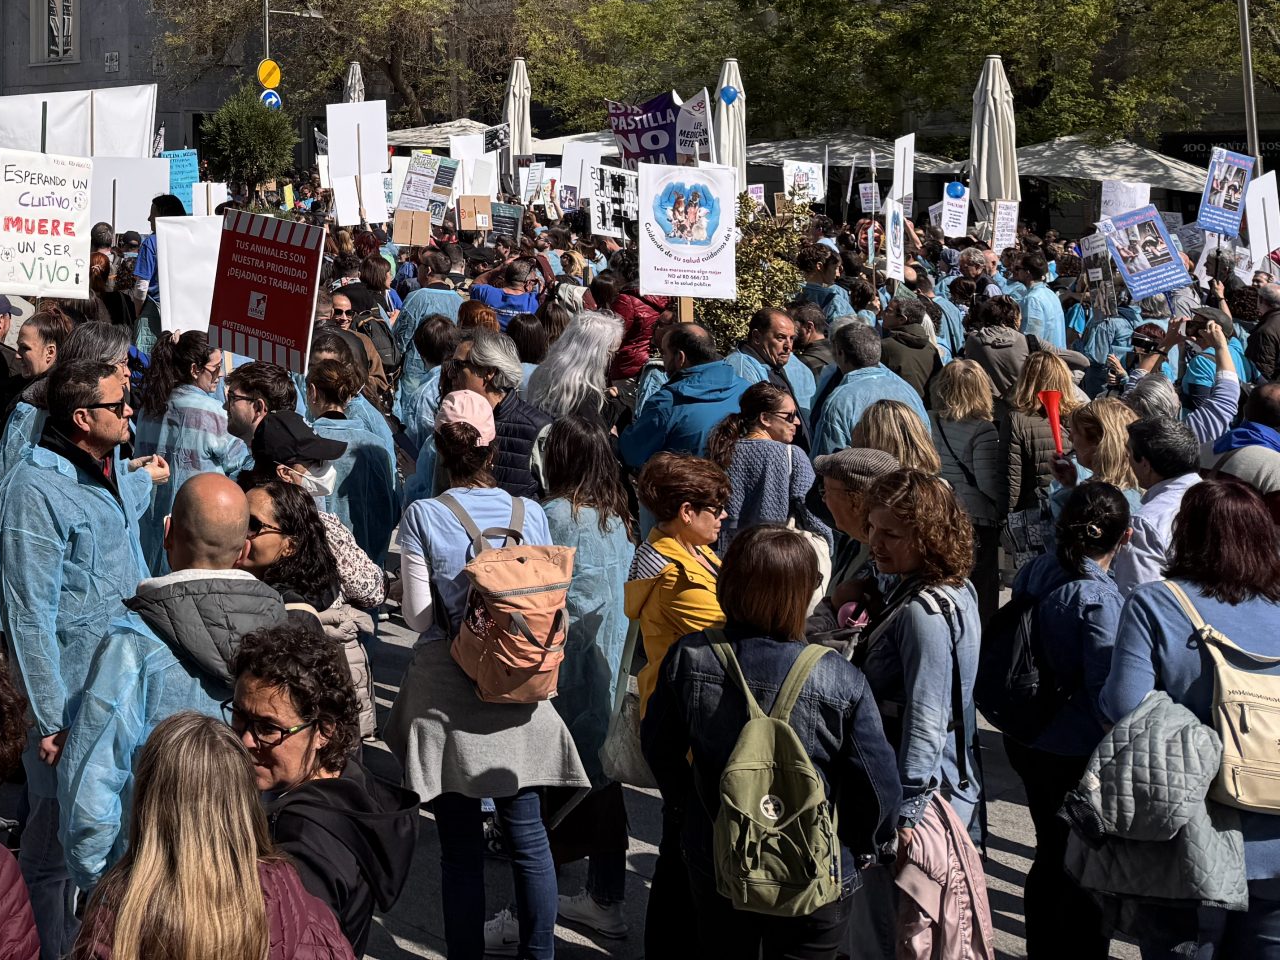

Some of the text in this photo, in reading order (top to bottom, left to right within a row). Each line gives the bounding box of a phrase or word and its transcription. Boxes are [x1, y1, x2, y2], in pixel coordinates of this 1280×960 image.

[692, 101, 705, 112] ce
[611, 108, 676, 130] PASTILLA
[614, 129, 670, 153] NO
[1183, 143, 1206, 152] 100
[72, 179, 88, 189] UN
[3, 216, 76, 237] MUERE
[17, 241, 71, 257] UN SER
[235, 240, 307, 265] TUS ANIMALES SON
[644, 222, 664, 253] Cuidando
[664, 250, 673, 258] de
[701, 242, 727, 262] cuidamos
[725, 232, 731, 242] de
[231, 253, 308, 280] NUESTRA PRIORIDAD
[227, 268, 308, 295] ¡DEJADNOS TRABAJAR!
